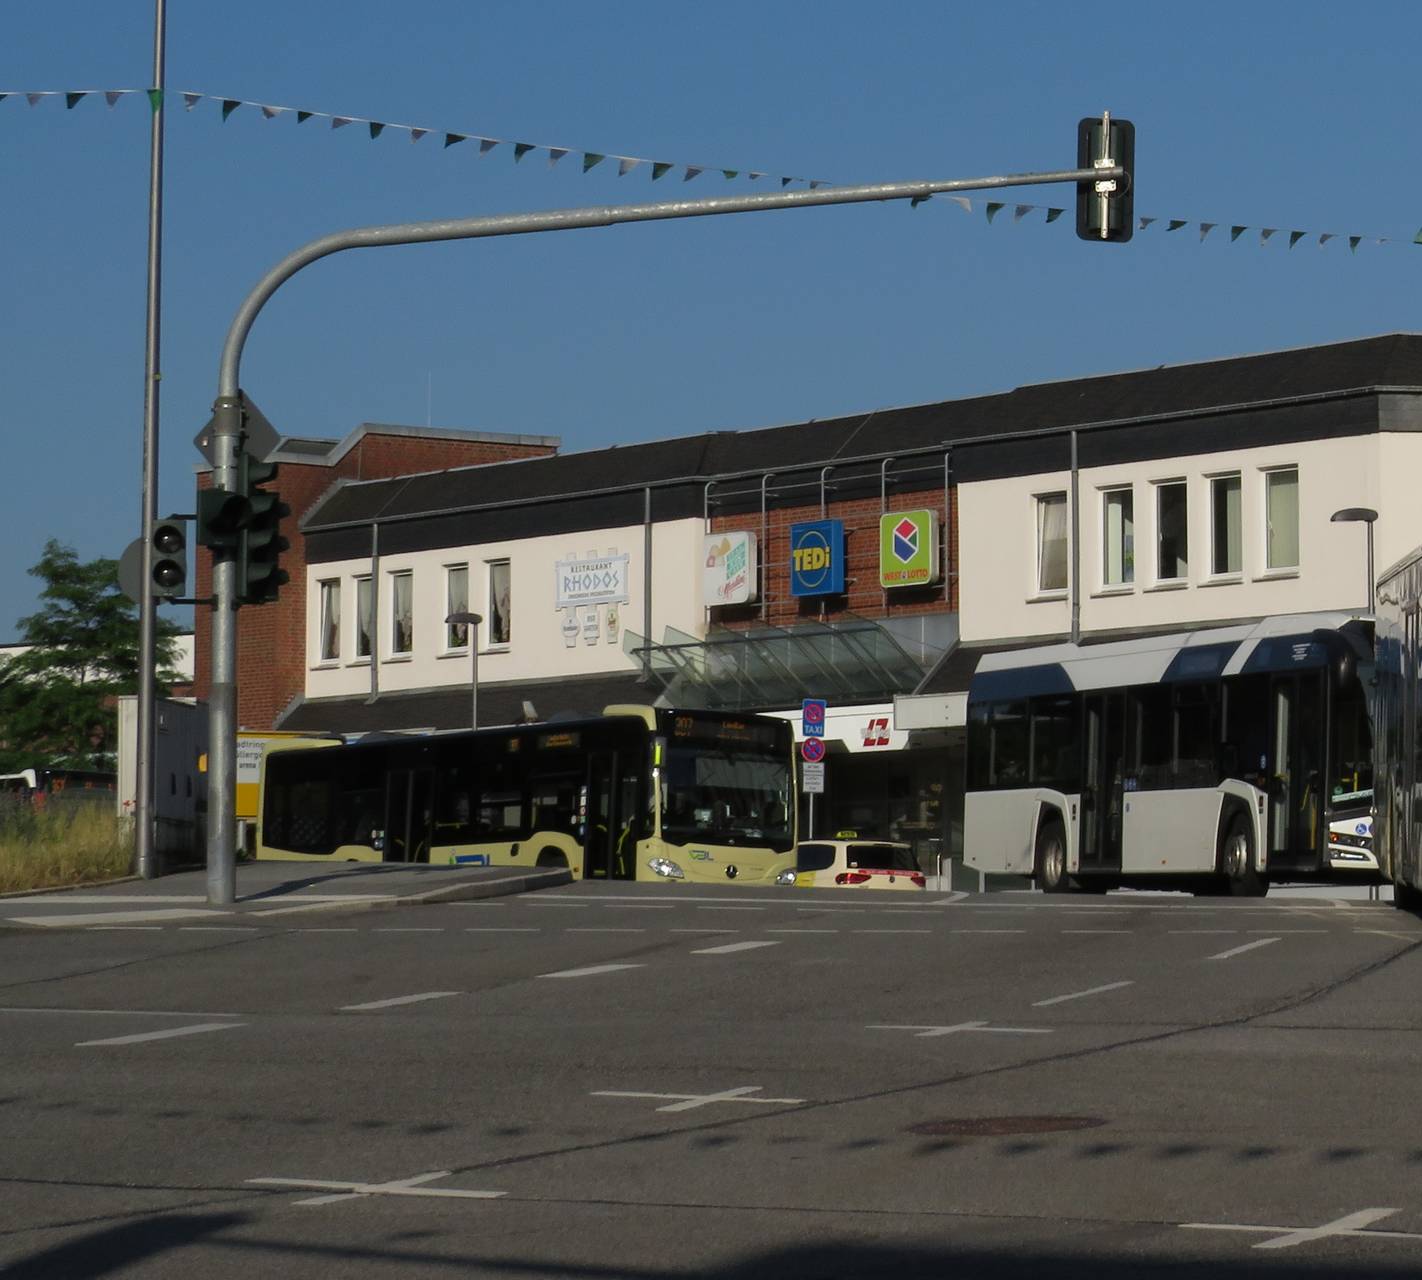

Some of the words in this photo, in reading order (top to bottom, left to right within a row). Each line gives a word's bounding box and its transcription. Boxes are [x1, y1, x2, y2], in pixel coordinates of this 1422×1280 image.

[793, 546, 830, 571] TEDi
[571, 562, 612, 573] RESTAURANT
[564, 570, 619, 592] RHODOS
[884, 571, 901, 581] WEST
[907, 569, 928, 579] LOTTO
[804, 724, 823, 735] TAXI
